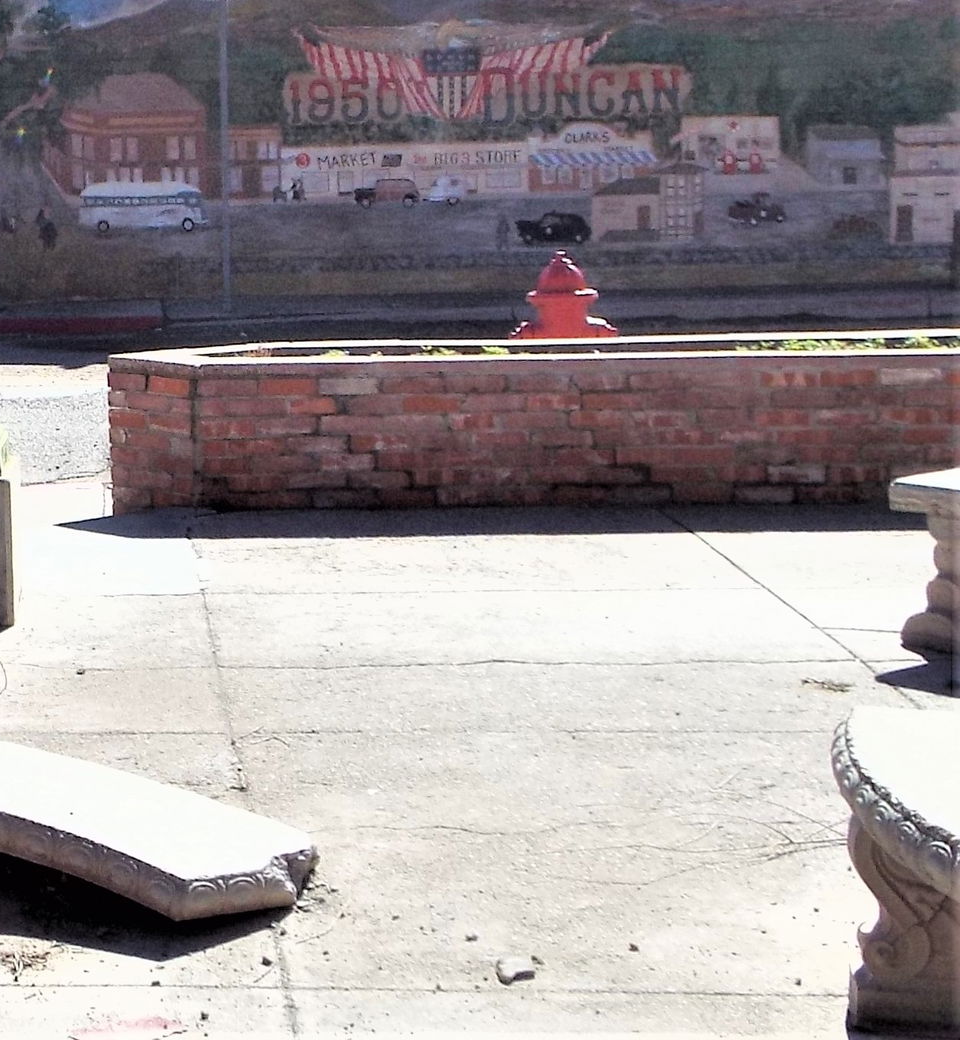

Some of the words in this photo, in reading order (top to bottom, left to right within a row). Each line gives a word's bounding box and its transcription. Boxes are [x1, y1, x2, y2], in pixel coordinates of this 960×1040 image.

[289, 75, 403, 124] 1950
[480, 67, 682, 126] DUNCAN
[317, 151, 377, 171] MARKET
